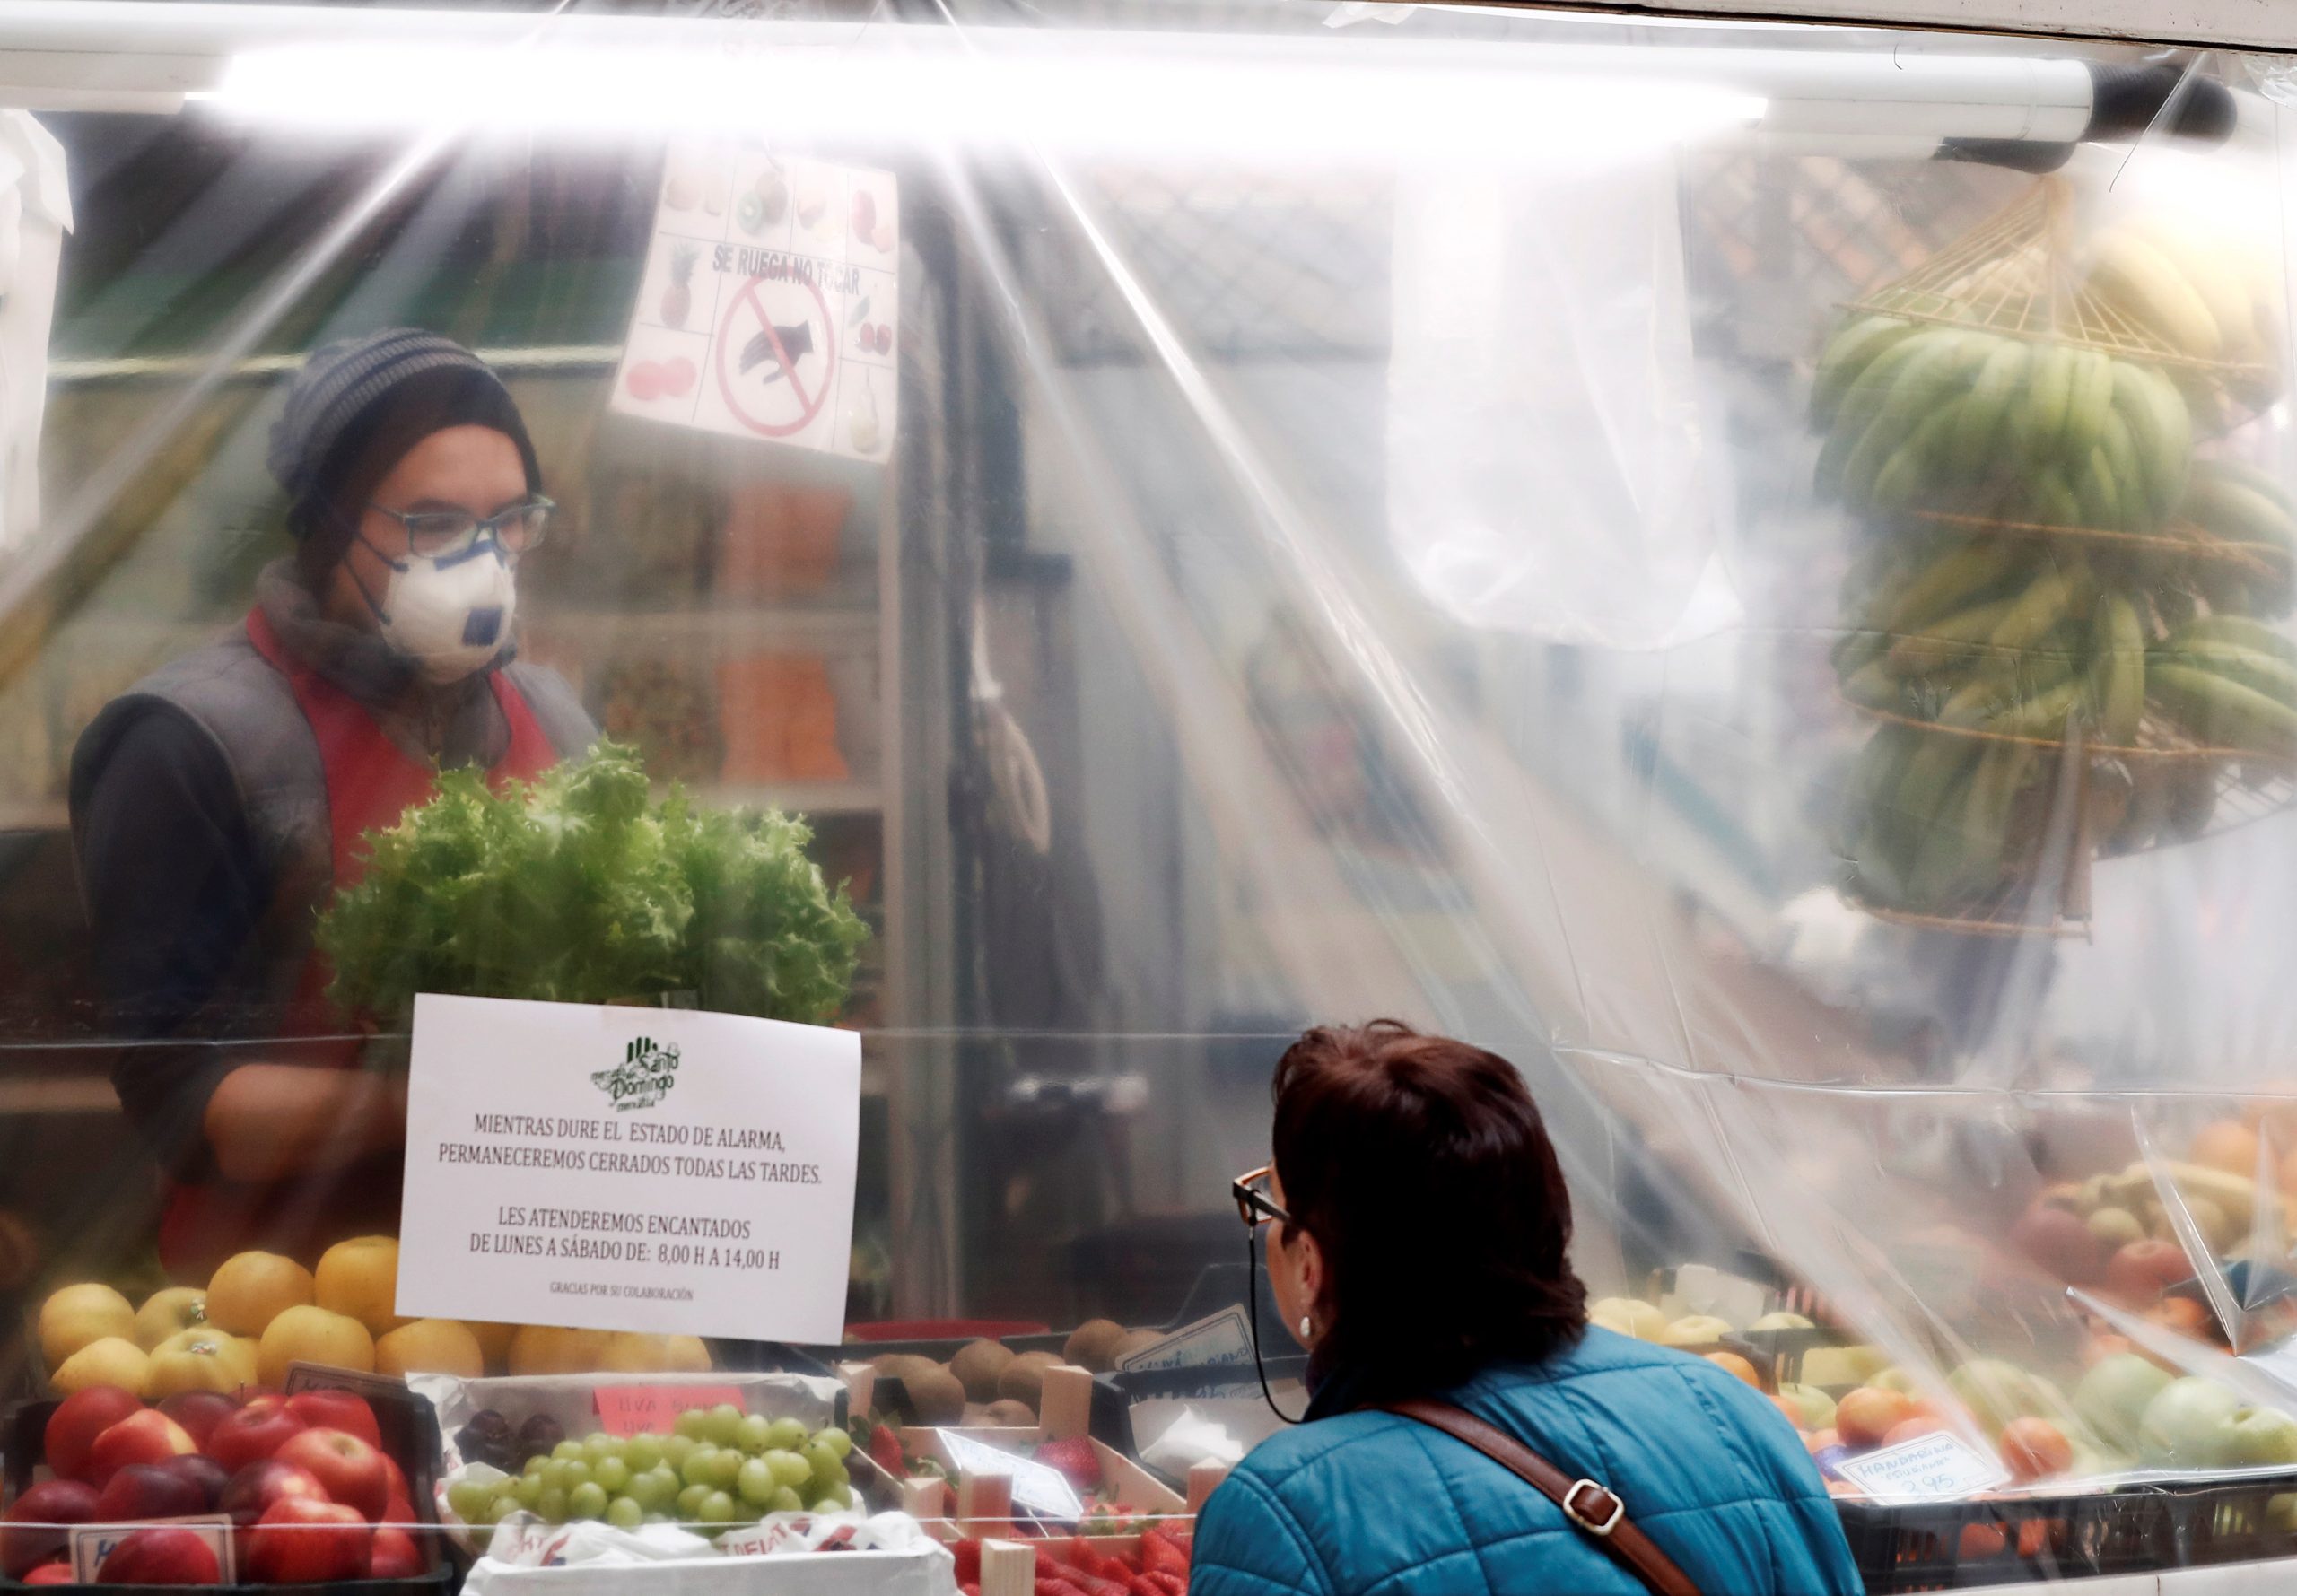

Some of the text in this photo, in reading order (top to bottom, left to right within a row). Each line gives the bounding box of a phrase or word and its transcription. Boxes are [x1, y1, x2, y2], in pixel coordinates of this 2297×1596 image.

[712, 244, 860, 295] SE RUEGA NO TOCAR
[474, 1113, 786, 1154] MIENTRAS DURE EL ESTADO DE ALARMA,
[438, 1142, 822, 1185] PERMANECEREMOS CERRADOS TODAS LAS TARDES.
[498, 1206, 751, 1240] LES ATENDEREMOS ENCANTADOS
[469, 1233, 780, 1270] DE LUNES A SÁBADO DE: 8,00 H A 14,00 H
[549, 1281, 588, 1295] GRACIAS
[590, 1283, 608, 1296] POR
